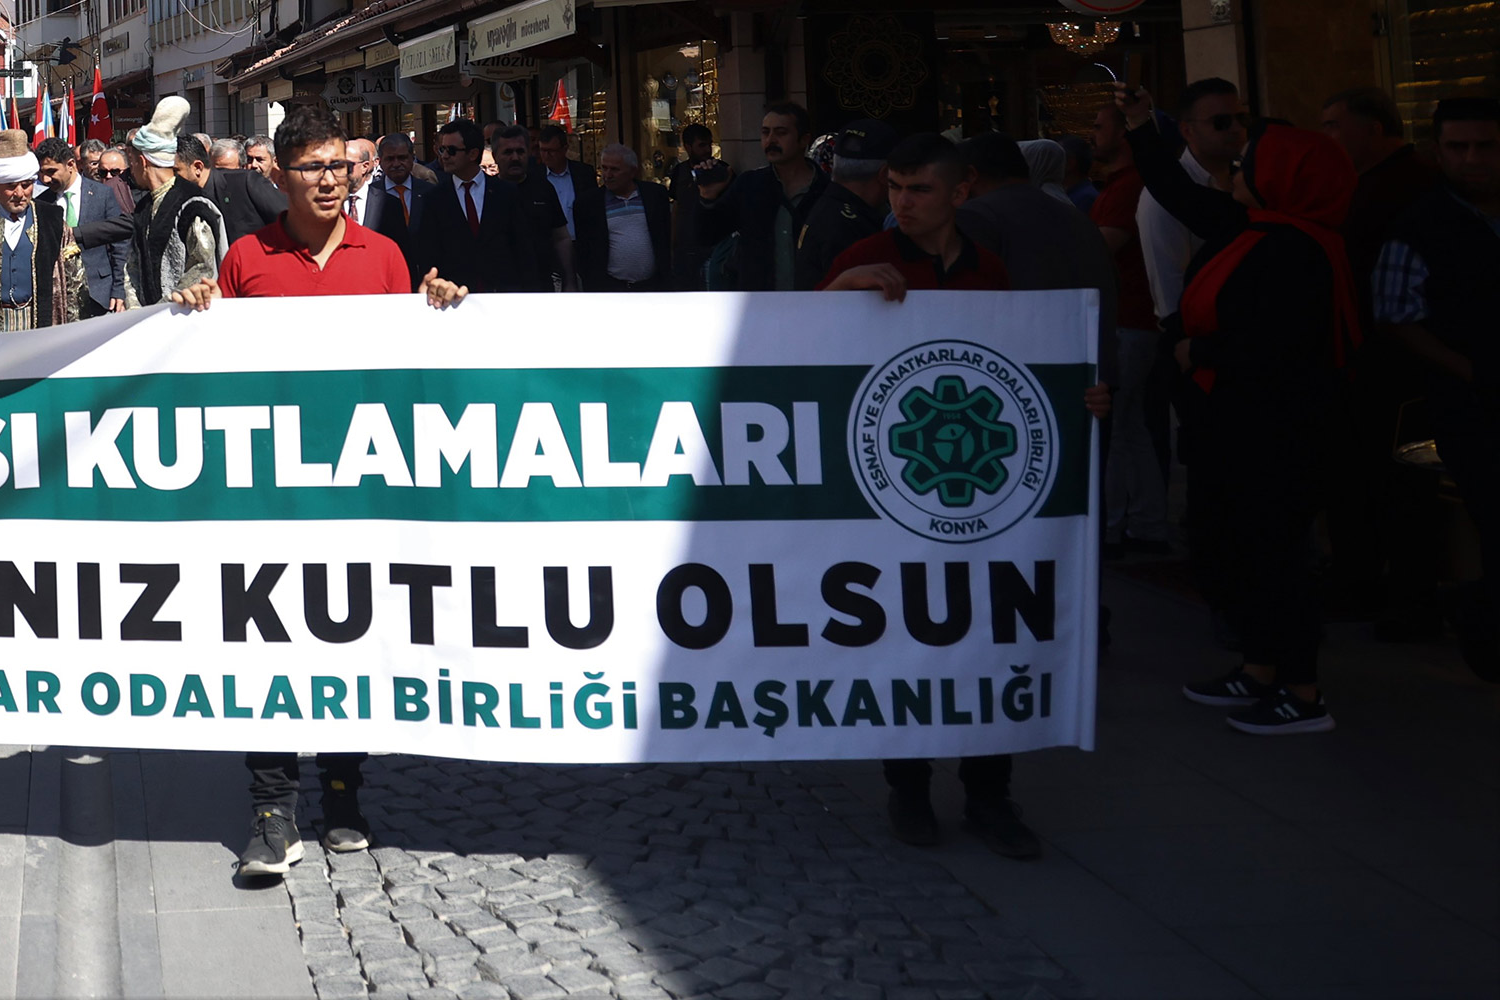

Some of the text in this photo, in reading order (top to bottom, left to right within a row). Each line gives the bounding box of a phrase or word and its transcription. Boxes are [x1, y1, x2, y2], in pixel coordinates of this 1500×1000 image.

[64, 402, 822, 491] KUTLAMALARI
[862, 349, 1047, 492] ESNAF VE SANATKARLAR ODALARI BİRLİĞİ
[929, 518, 988, 535] KONYA
[221, 562, 614, 650] KUTLU
[656, 560, 1056, 650] OLSUN
[80, 671, 371, 720] ODALARI
[659, 665, 1052, 738] BAŞKANLIĞI
